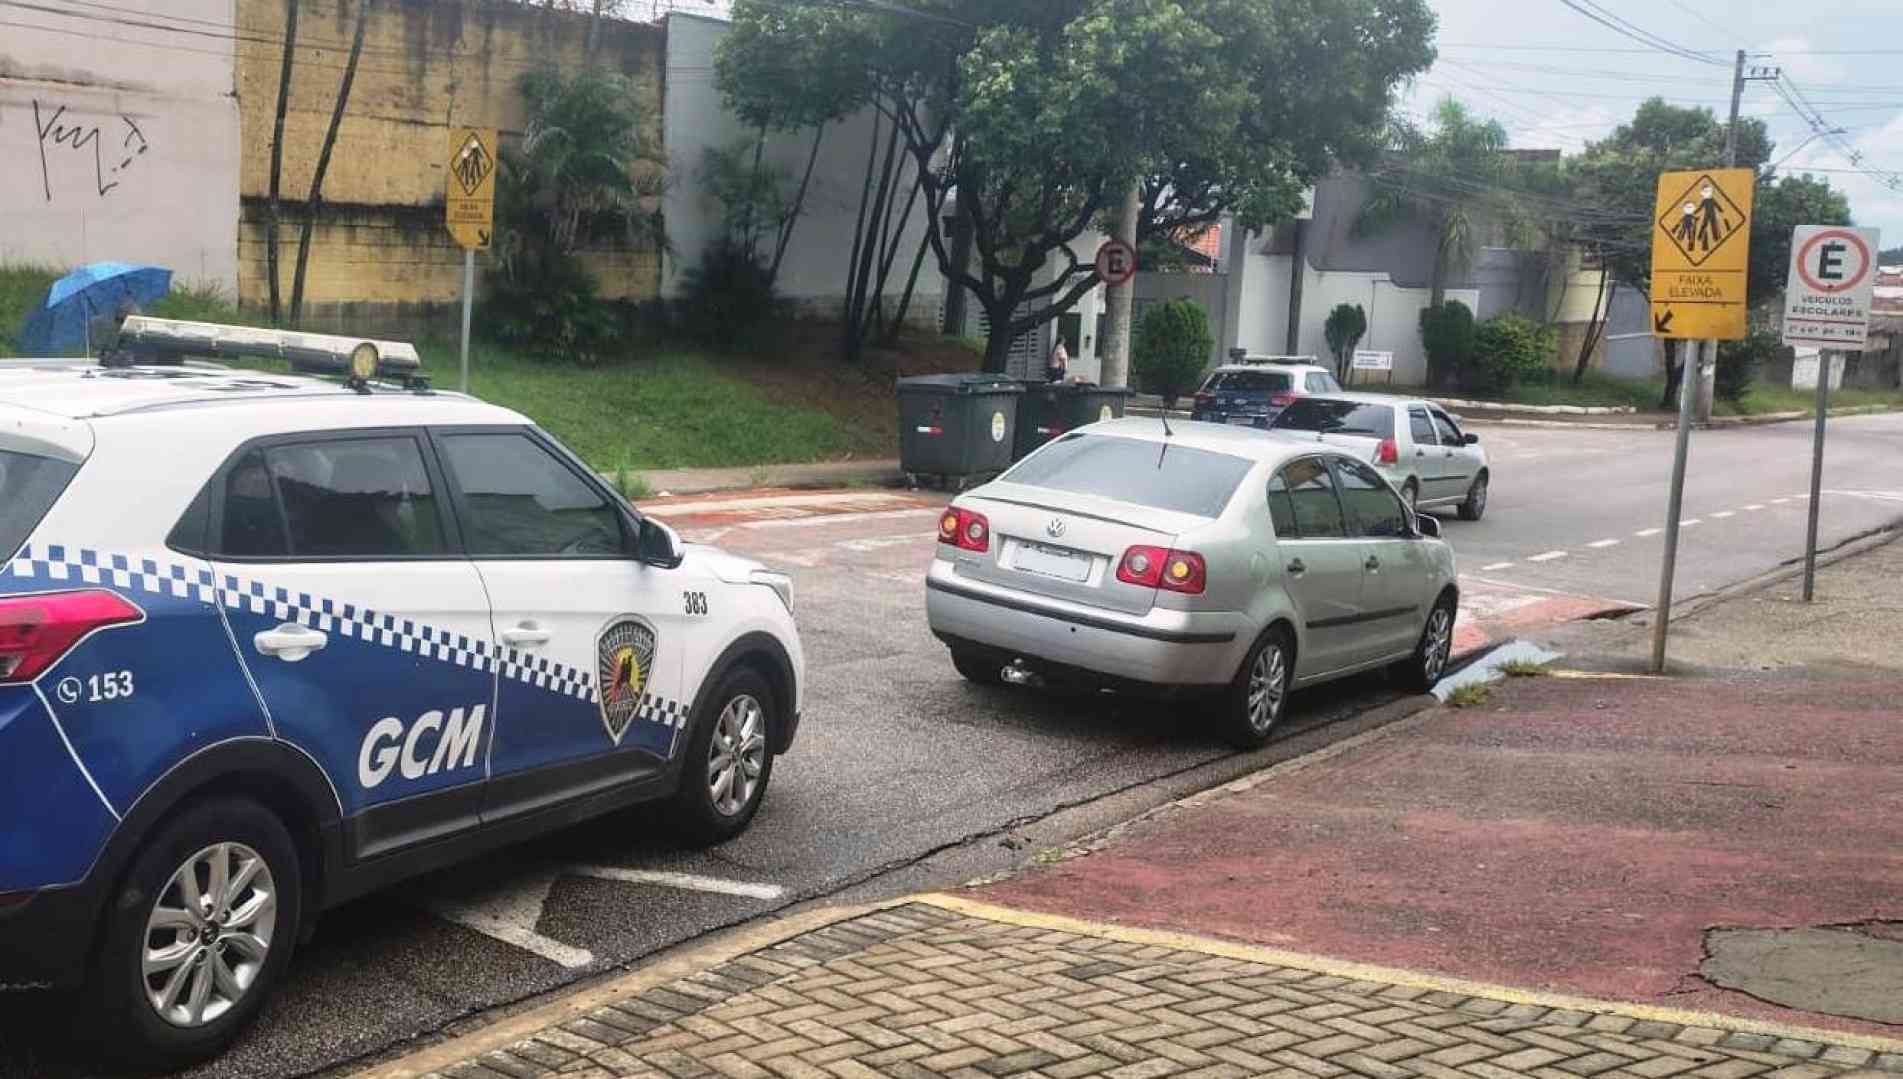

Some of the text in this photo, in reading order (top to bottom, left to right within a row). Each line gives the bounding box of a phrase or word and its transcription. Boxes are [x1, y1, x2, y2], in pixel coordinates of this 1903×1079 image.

[1108, 248, 1123, 274] E
[1819, 244, 1846, 280] E
[1668, 286, 1723, 298] ELEVADA
[1679, 273, 1713, 286] FAIXA
[683, 591, 708, 615] 383
[88, 669, 134, 702] 153
[358, 703, 487, 789] GCM
